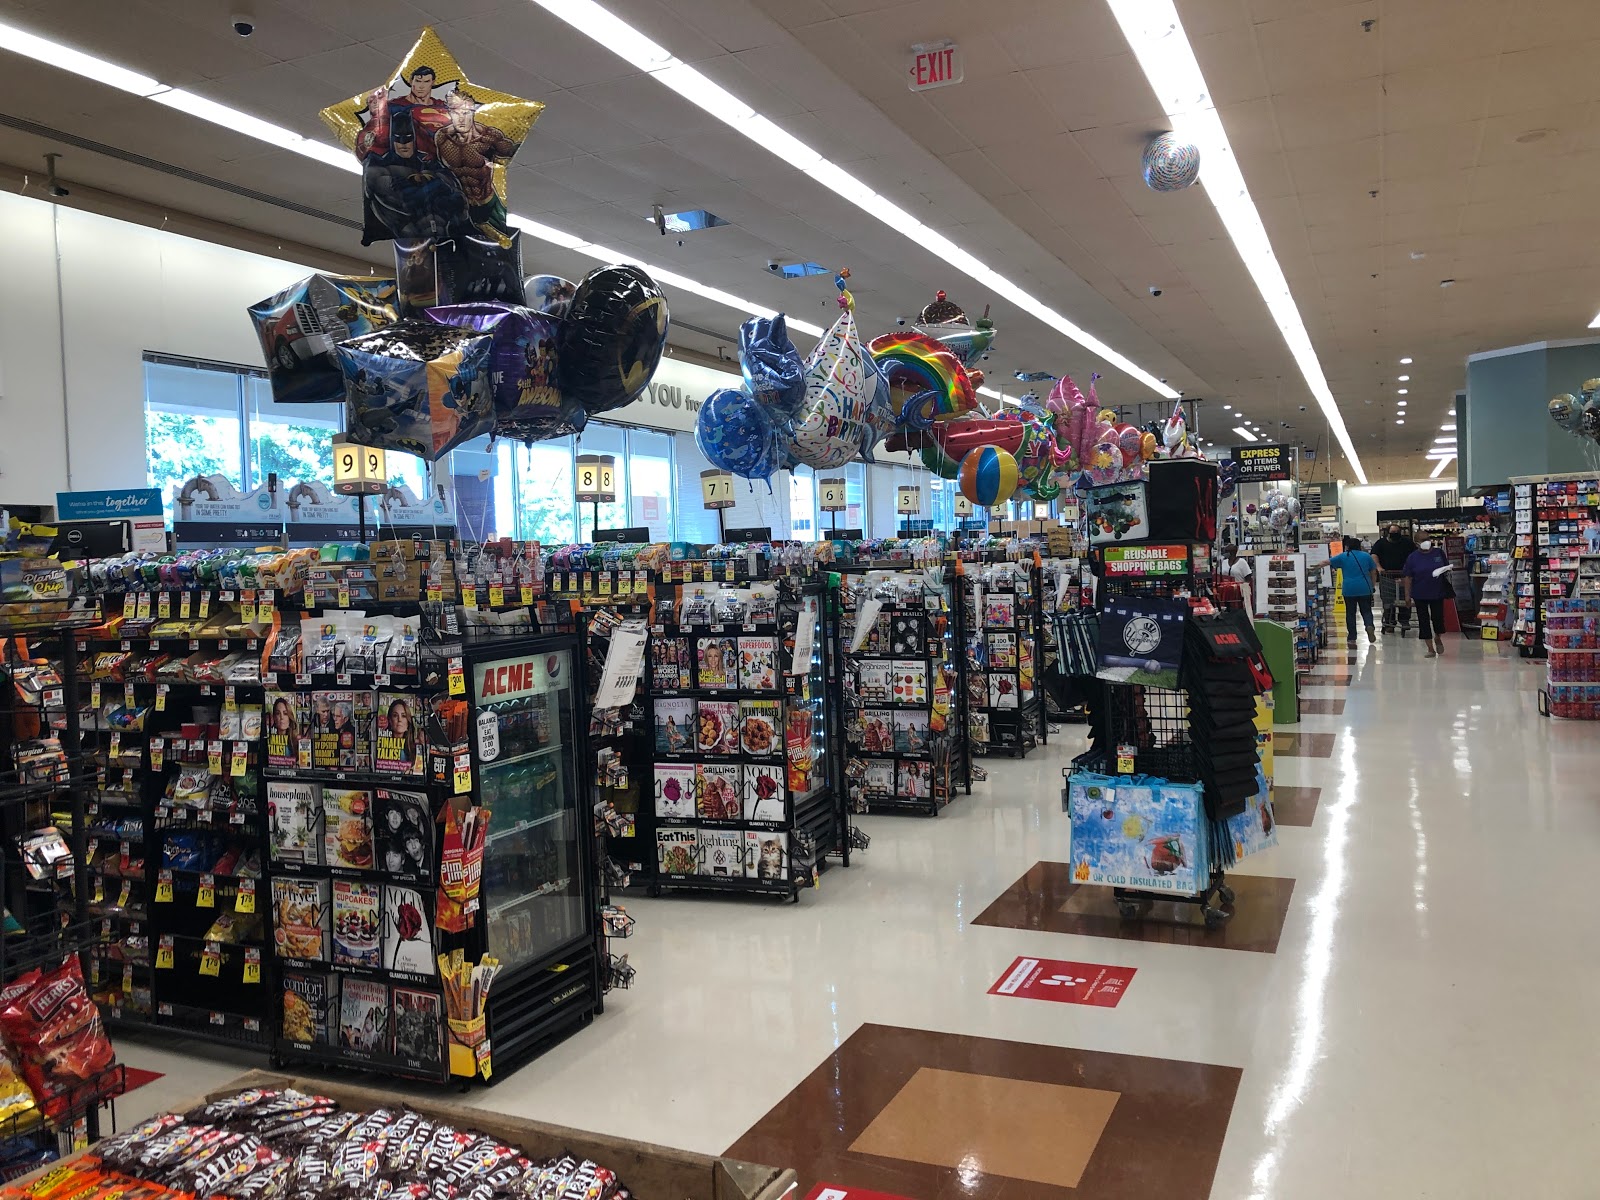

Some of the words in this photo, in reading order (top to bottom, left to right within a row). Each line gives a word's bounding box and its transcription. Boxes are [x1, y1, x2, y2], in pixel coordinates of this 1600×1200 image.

[916, 49, 954, 85] EXIT
[517, 378, 531, 390] Still
[650, 383, 682, 409] YOU
[685, 395, 703, 412] fro
[842, 396, 865, 421] HAP
[827, 415, 864, 443] BIRTH
[1240, 448, 1280, 459] EXPRESS
[343, 454, 353, 473] 9
[368, 454, 378, 472] 9
[1254, 457, 1278, 465] ITEMS
[1253, 464, 1281, 472] FEWER
[583, 471, 593, 486] 8
[603, 472, 610, 486] 8
[708, 483, 716, 496] 7
[724, 482, 729, 495] 7
[825, 490, 834, 501] 6
[839, 490, 844, 501] 6
[903, 496, 910, 505] 5
[105, 495, 149, 512] together
[959, 500, 965, 509] 4
[201, 509, 212, 517] SOME
[212, 509, 227, 517] PRETTY
[1038, 507, 1044, 515] 2
[414, 549, 430, 557] KIND
[1123, 548, 1168, 560] REUSABLE
[1111, 560, 1156, 572] SHOPPING
[1157, 560, 1182, 571] BAGS
[739, 641, 772, 649] SUPERFOODS
[1214, 633, 1242, 645] ACME
[700, 668, 714, 677] Just
[481, 662, 533, 698] ACME
[699, 675, 726, 683] Married!
[478, 716, 496, 727] BALANCE
[377, 728, 393, 738] Kate
[482, 734, 495, 743] DRINK
[268, 734, 289, 746] NALLY
[320, 741, 338, 750] EPSTEIN
[377, 737, 406, 749] FINALLY
[377, 747, 401, 760] TALKS!
[433, 762, 446, 773] CUT
[746, 766, 783, 780] VOGUE
[900, 762, 930, 772] SHPE
[269, 787, 312, 802] houseplants
[377, 789, 390, 799] LIFE
[392, 793, 420, 806] BEATLES
[700, 833, 740, 848] lighting
[746, 840, 759, 848] Cats
[441, 860, 462, 873] slim
[463, 860, 481, 877] slim
[1075, 870, 1090, 881] HOT
[1093, 873, 1103, 882] OR
[1106, 874, 1126, 884] COLD
[1129, 876, 1172, 890] INSULATED
[1176, 880, 1194, 891] BAG
[288, 890, 318, 905] fryer
[336, 893, 376, 906] CUPCAKES!
[409, 973, 428, 984] VOGUE
[283, 976, 323, 996] comfort
[343, 979, 367, 992] Better
[306, 991, 322, 1001] food
[354, 990, 384, 1004] Gardens
[293, 1042, 311, 1050] more
[407, 1060, 421, 1068] TIME
